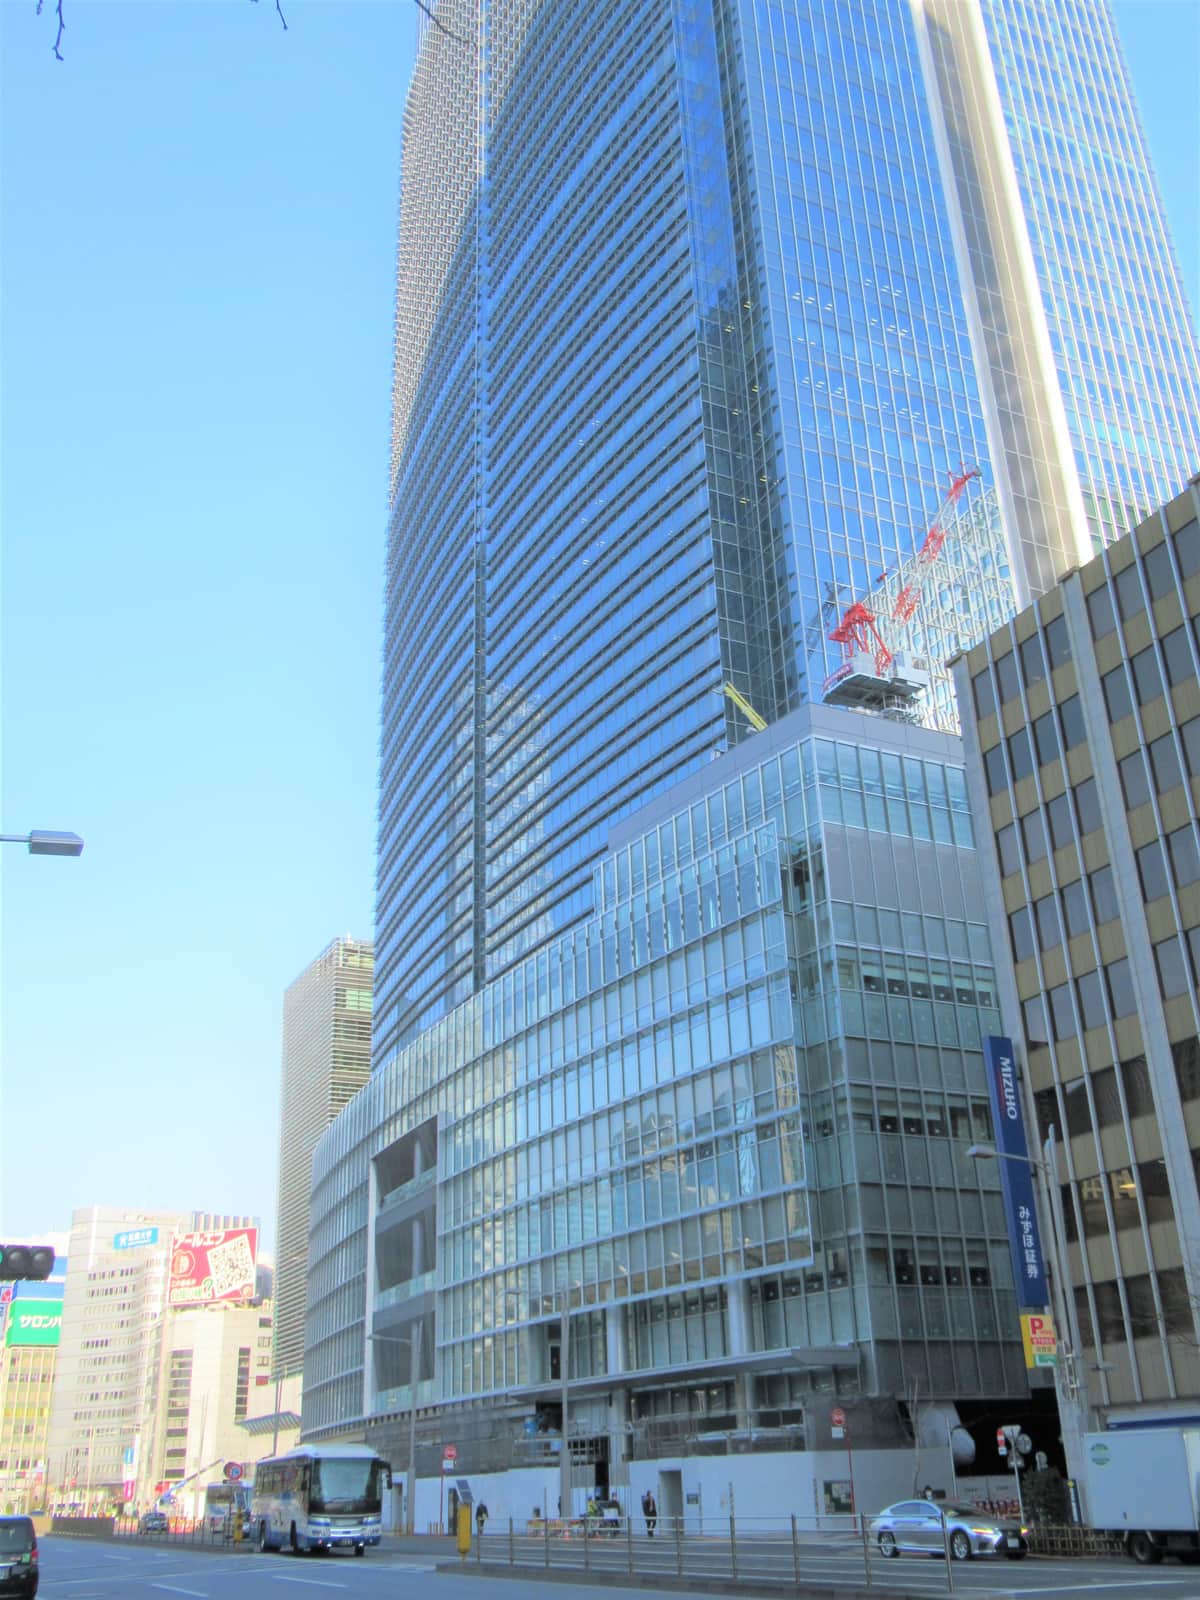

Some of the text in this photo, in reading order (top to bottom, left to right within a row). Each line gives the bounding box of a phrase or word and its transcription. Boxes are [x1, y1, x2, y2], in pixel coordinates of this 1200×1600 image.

[1000, 1056, 1018, 1120] MIZUHO
[1019, 1205, 1038, 1279] みずほ証券
